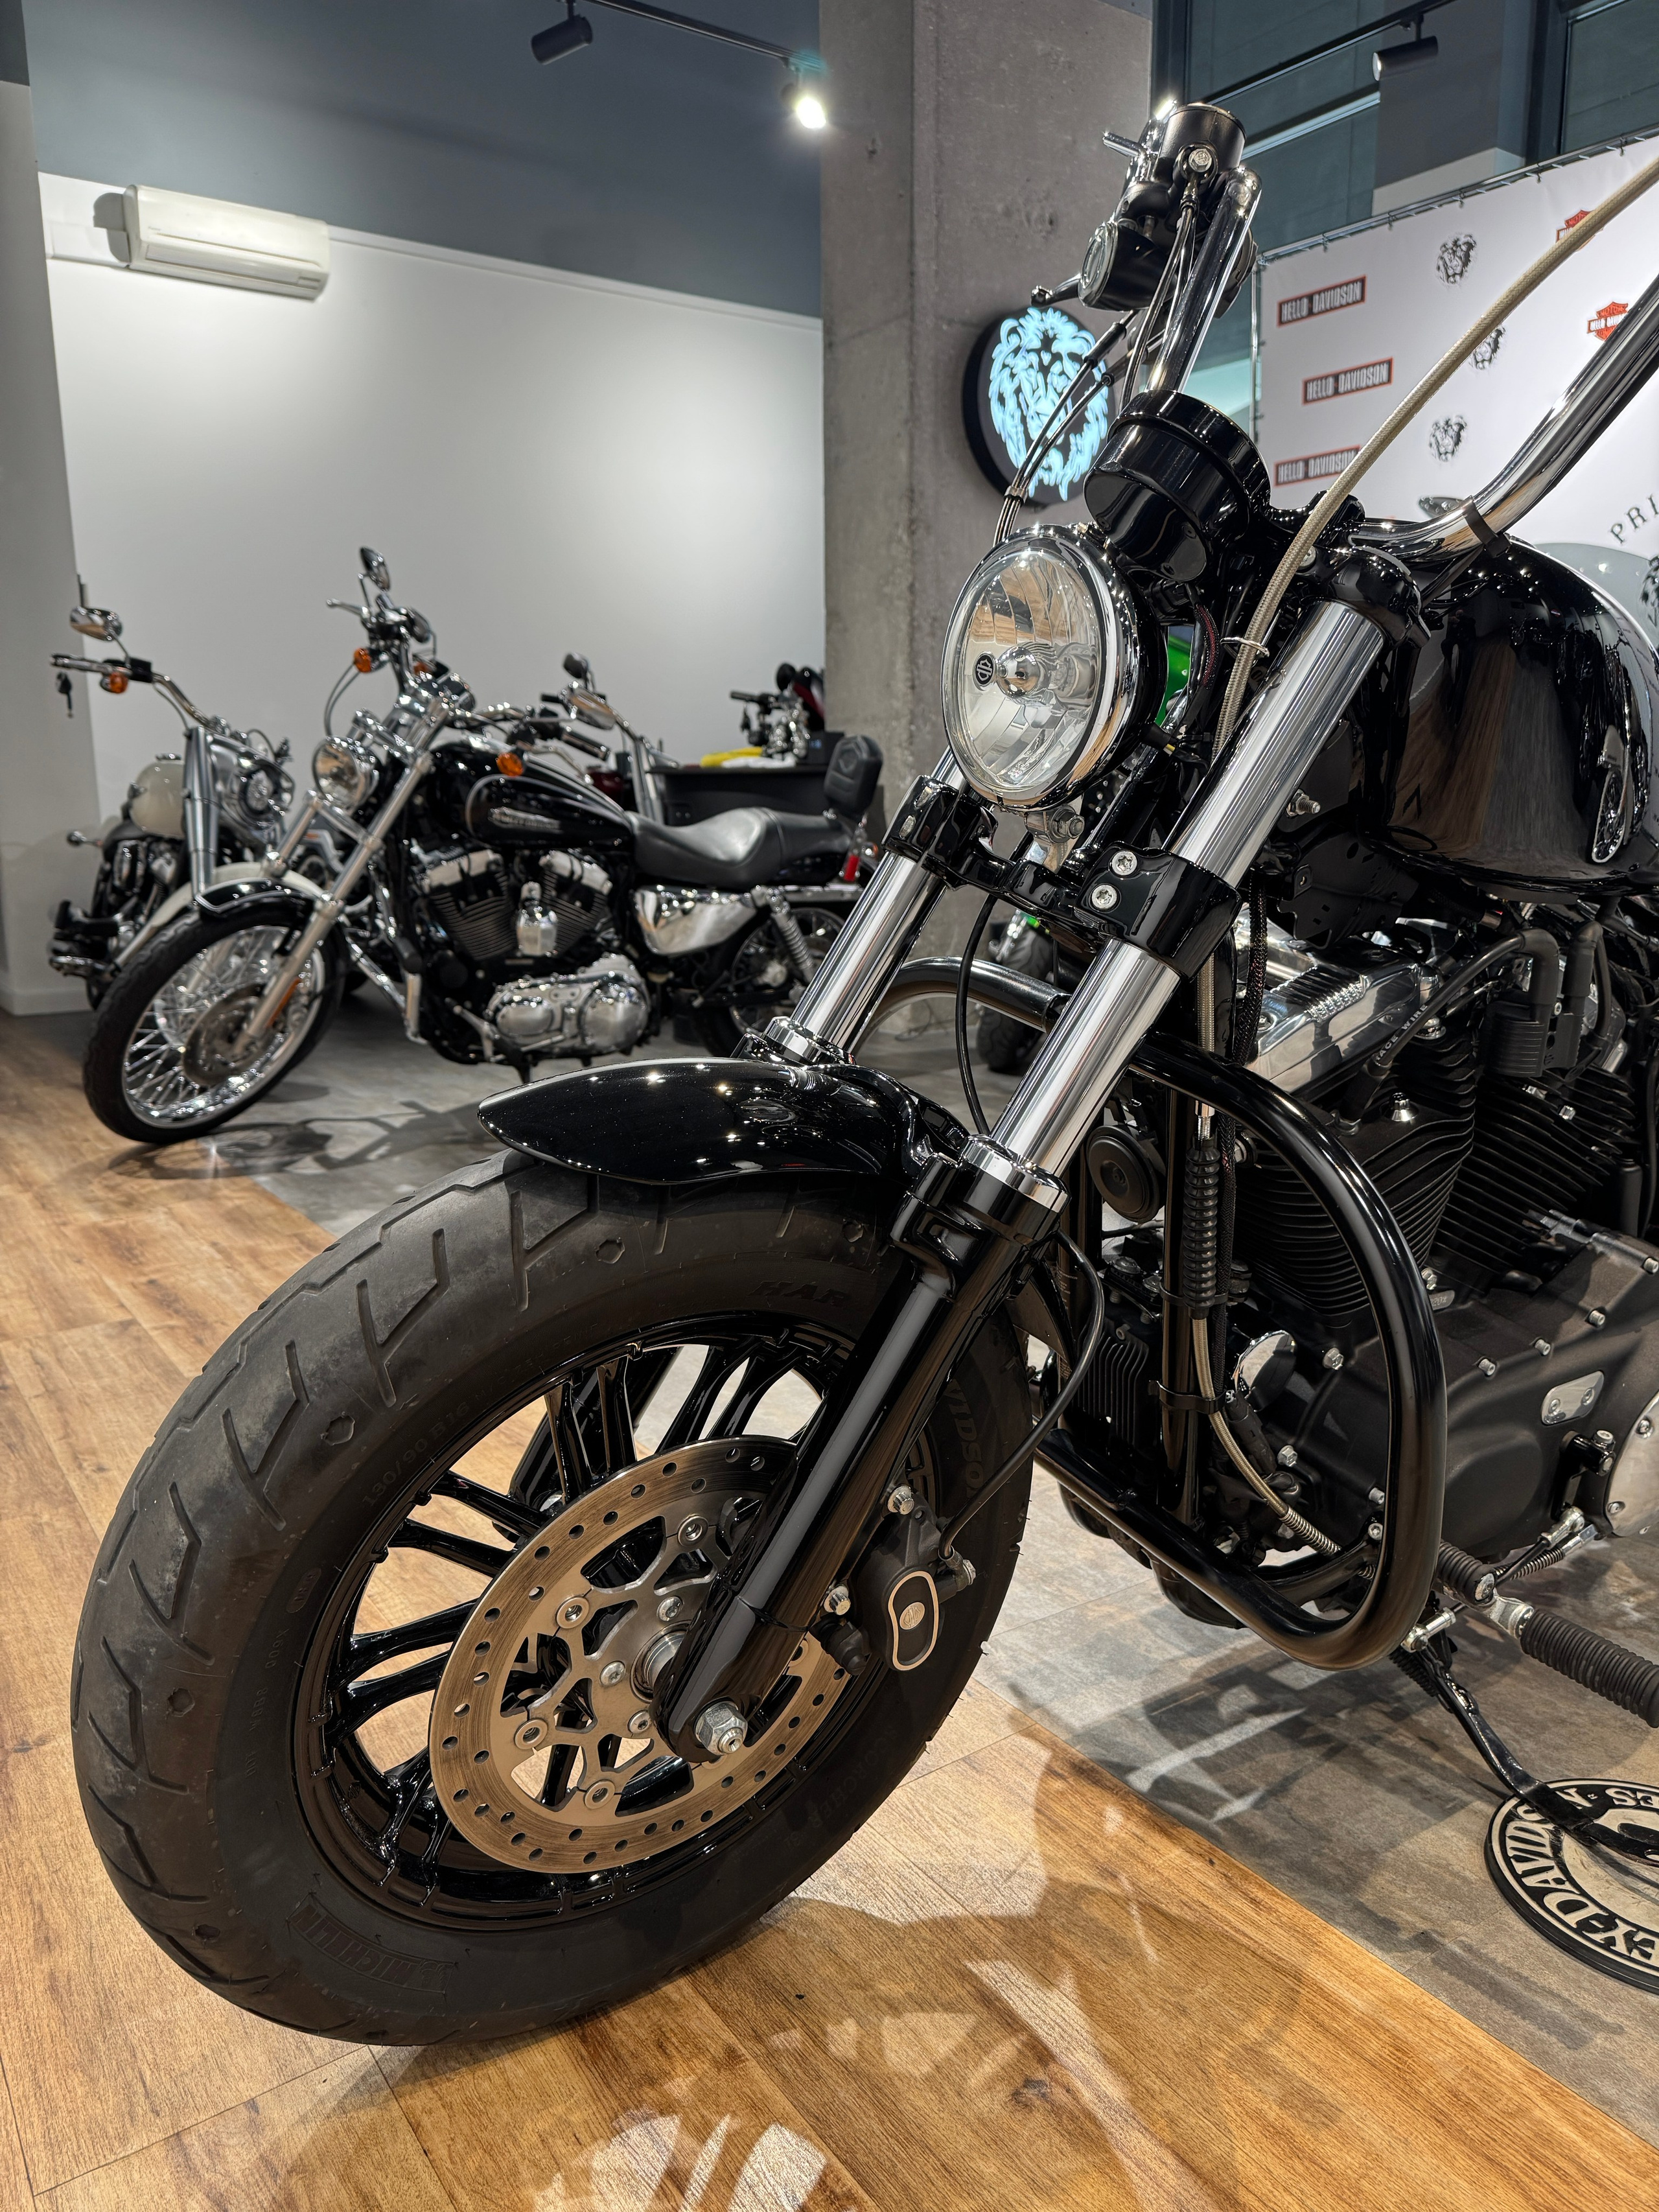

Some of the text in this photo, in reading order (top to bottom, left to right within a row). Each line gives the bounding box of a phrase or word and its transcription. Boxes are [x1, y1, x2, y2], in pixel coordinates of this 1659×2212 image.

[1281, 281, 1362, 323] HELLO DAVIDSON
[1306, 362, 1389, 401] HELLO DAVIDSON
[1278, 460, 1305, 483] HELLO
[1609, 495, 1659, 544] PRI
[1401, 1004, 1428, 1030] WIRE
[944, 1379, 984, 1498] VIDSO
[362, 1438, 428, 1507] 130/90
[290, 1904, 417, 1985] MICHELIN
